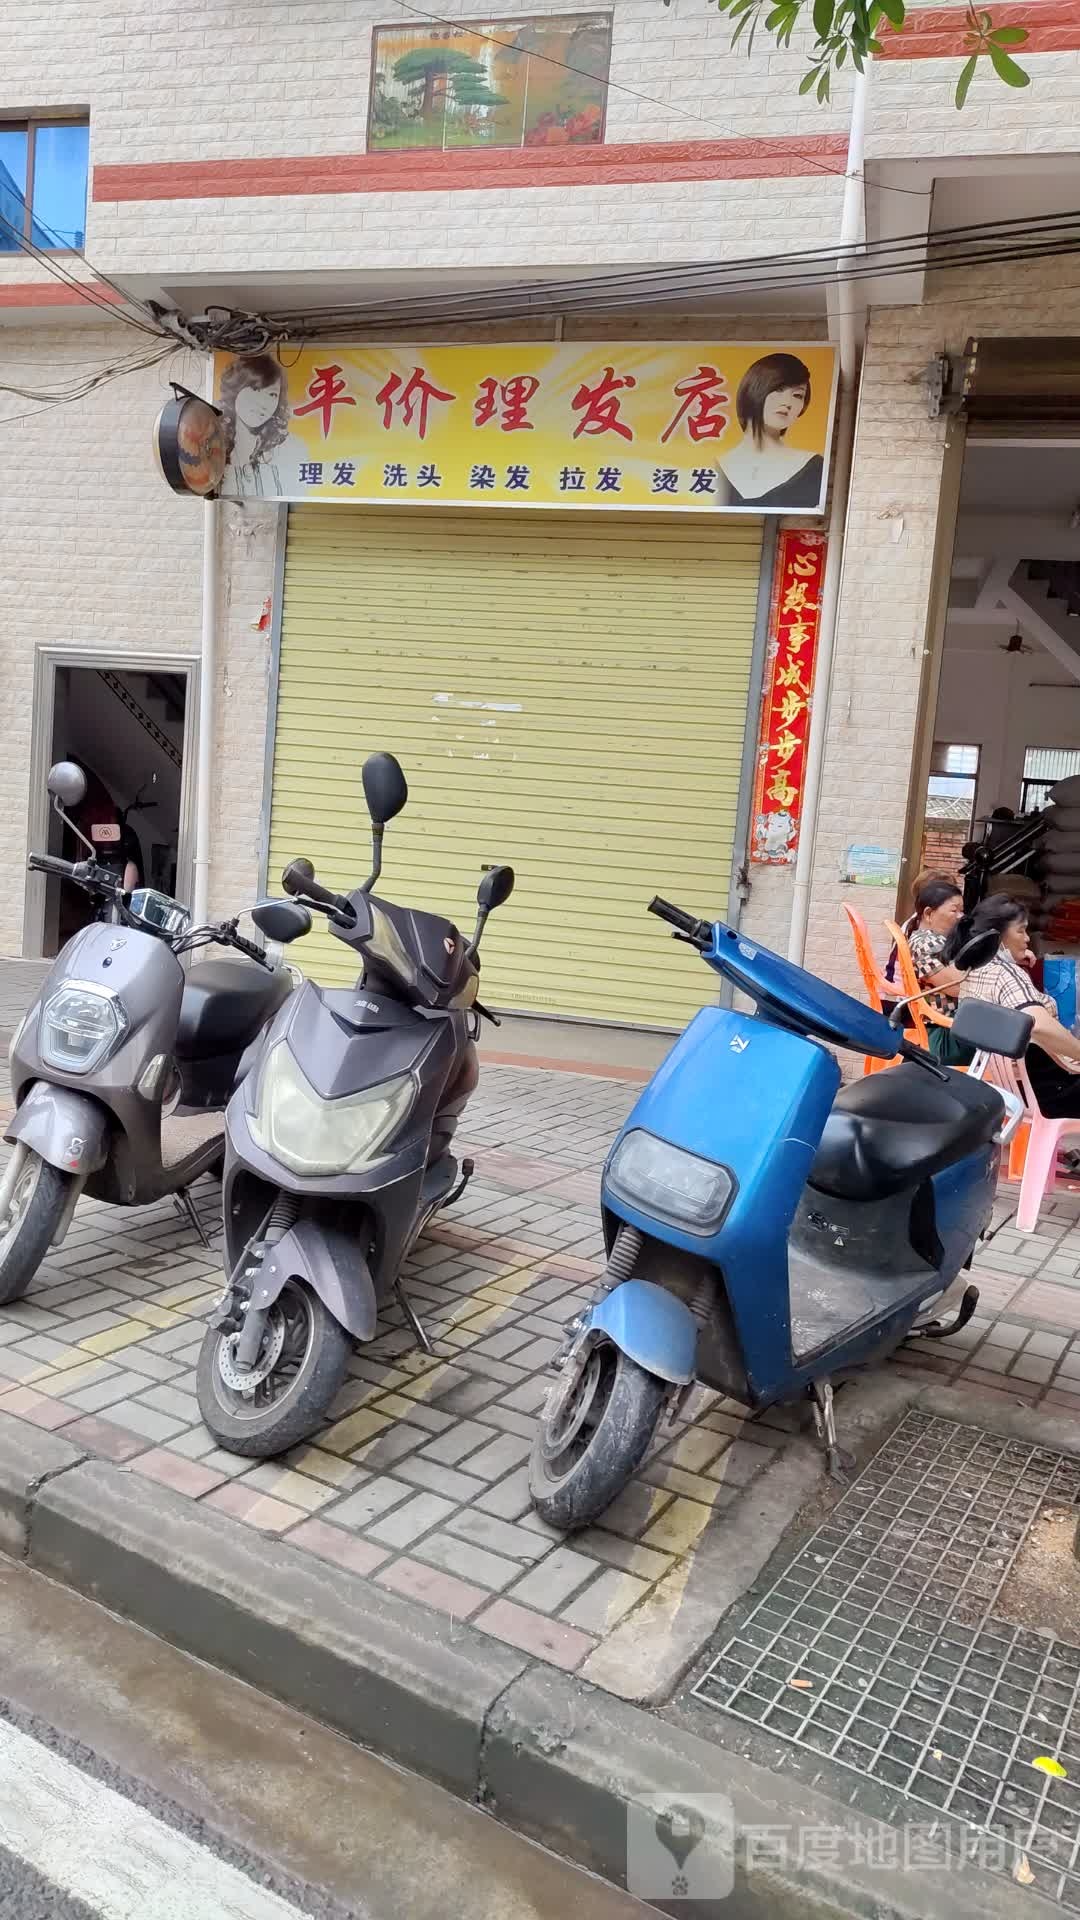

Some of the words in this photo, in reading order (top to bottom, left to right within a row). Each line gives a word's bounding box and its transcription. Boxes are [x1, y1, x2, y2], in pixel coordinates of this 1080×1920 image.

[293, 364, 729, 443] 平价理发店
[299, 462, 356, 486] 理发
[383, 463, 442, 488] 洗头
[470, 464, 530, 490] 染发
[559, 466, 622, 492] 拉发
[651, 468, 717, 494] 烫发
[766, 552, 818, 807] 心想事成步步高
